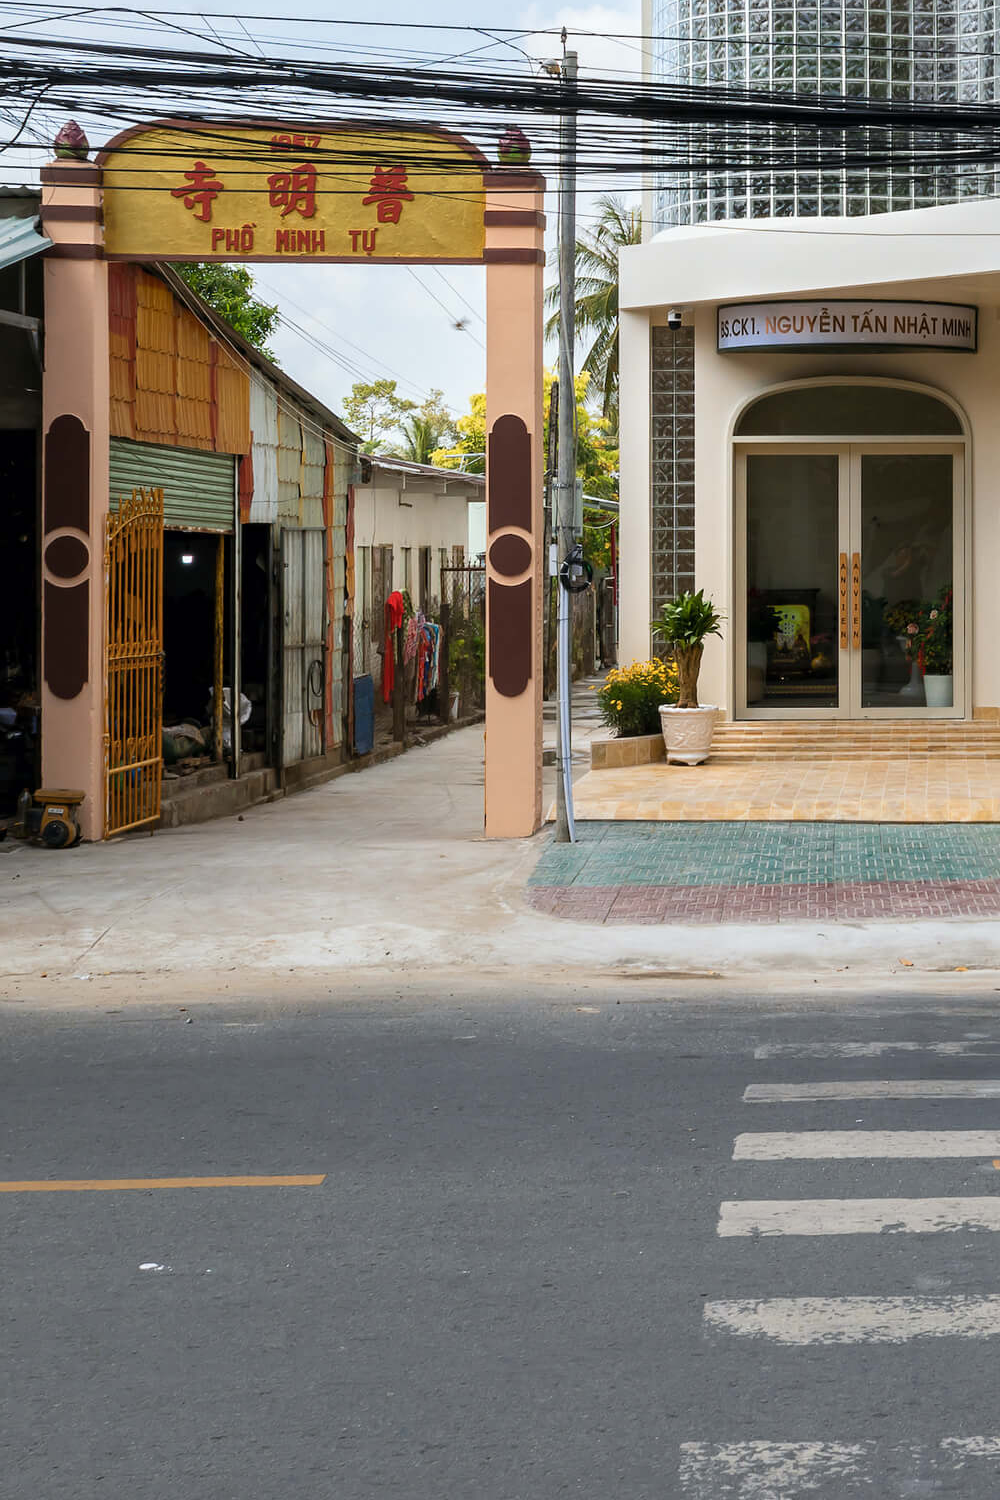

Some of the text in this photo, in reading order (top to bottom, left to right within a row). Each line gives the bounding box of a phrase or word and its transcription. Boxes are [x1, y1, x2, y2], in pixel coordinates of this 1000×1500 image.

[348, 227, 379, 256] TỰ
[765, 307, 846, 334] NGUYỄN
[851, 308, 888, 334] TẤN
[893, 312, 938, 338] NHẬT
[942, 317, 971, 338] MINH
